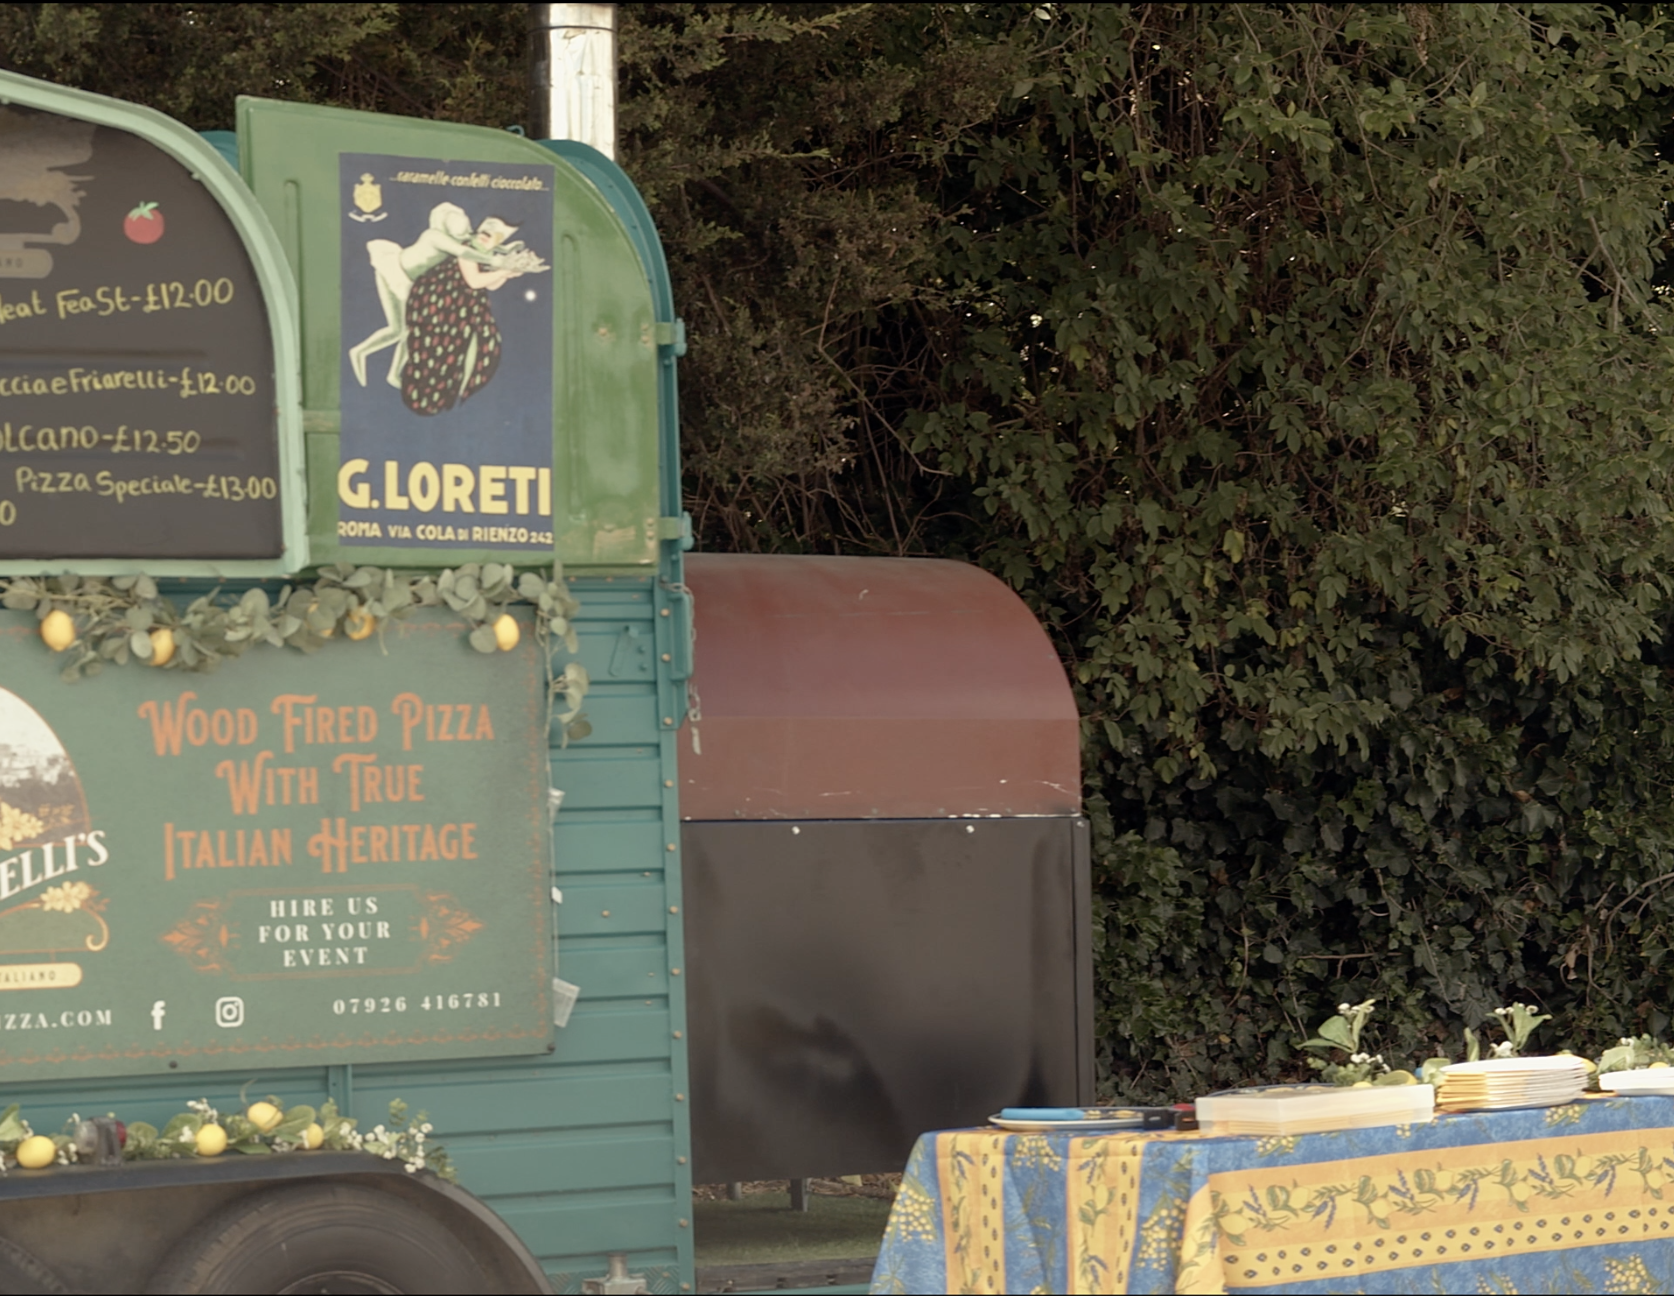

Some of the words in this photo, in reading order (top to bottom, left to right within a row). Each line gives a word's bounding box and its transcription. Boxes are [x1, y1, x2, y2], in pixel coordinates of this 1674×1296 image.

[337, 521, 382, 537] ROMA
[387, 525, 412, 539] VIA
[415, 524, 456, 541] COLA
[472, 526, 528, 543] RIENZO
[529, 532, 554, 544] 242
[137, 691, 258, 756] WOOD
[270, 693, 378, 753] FIRED
[391, 692, 496, 751] PIZZA
[215, 751, 319, 815] WITH
[332, 753, 425, 812] TRUE
[164, 822, 292, 880] ITALIAN
[307, 817, 478, 873] HERITAGE
[270, 898, 334, 918] HIRE
[347, 896, 379, 915] US
[258, 924, 310, 943] FOR
[322, 921, 391, 940] YOUR
[283, 947, 368, 967] EVENT
[333, 997, 407, 1014] 07926
[421, 992, 501, 1010] 416781
